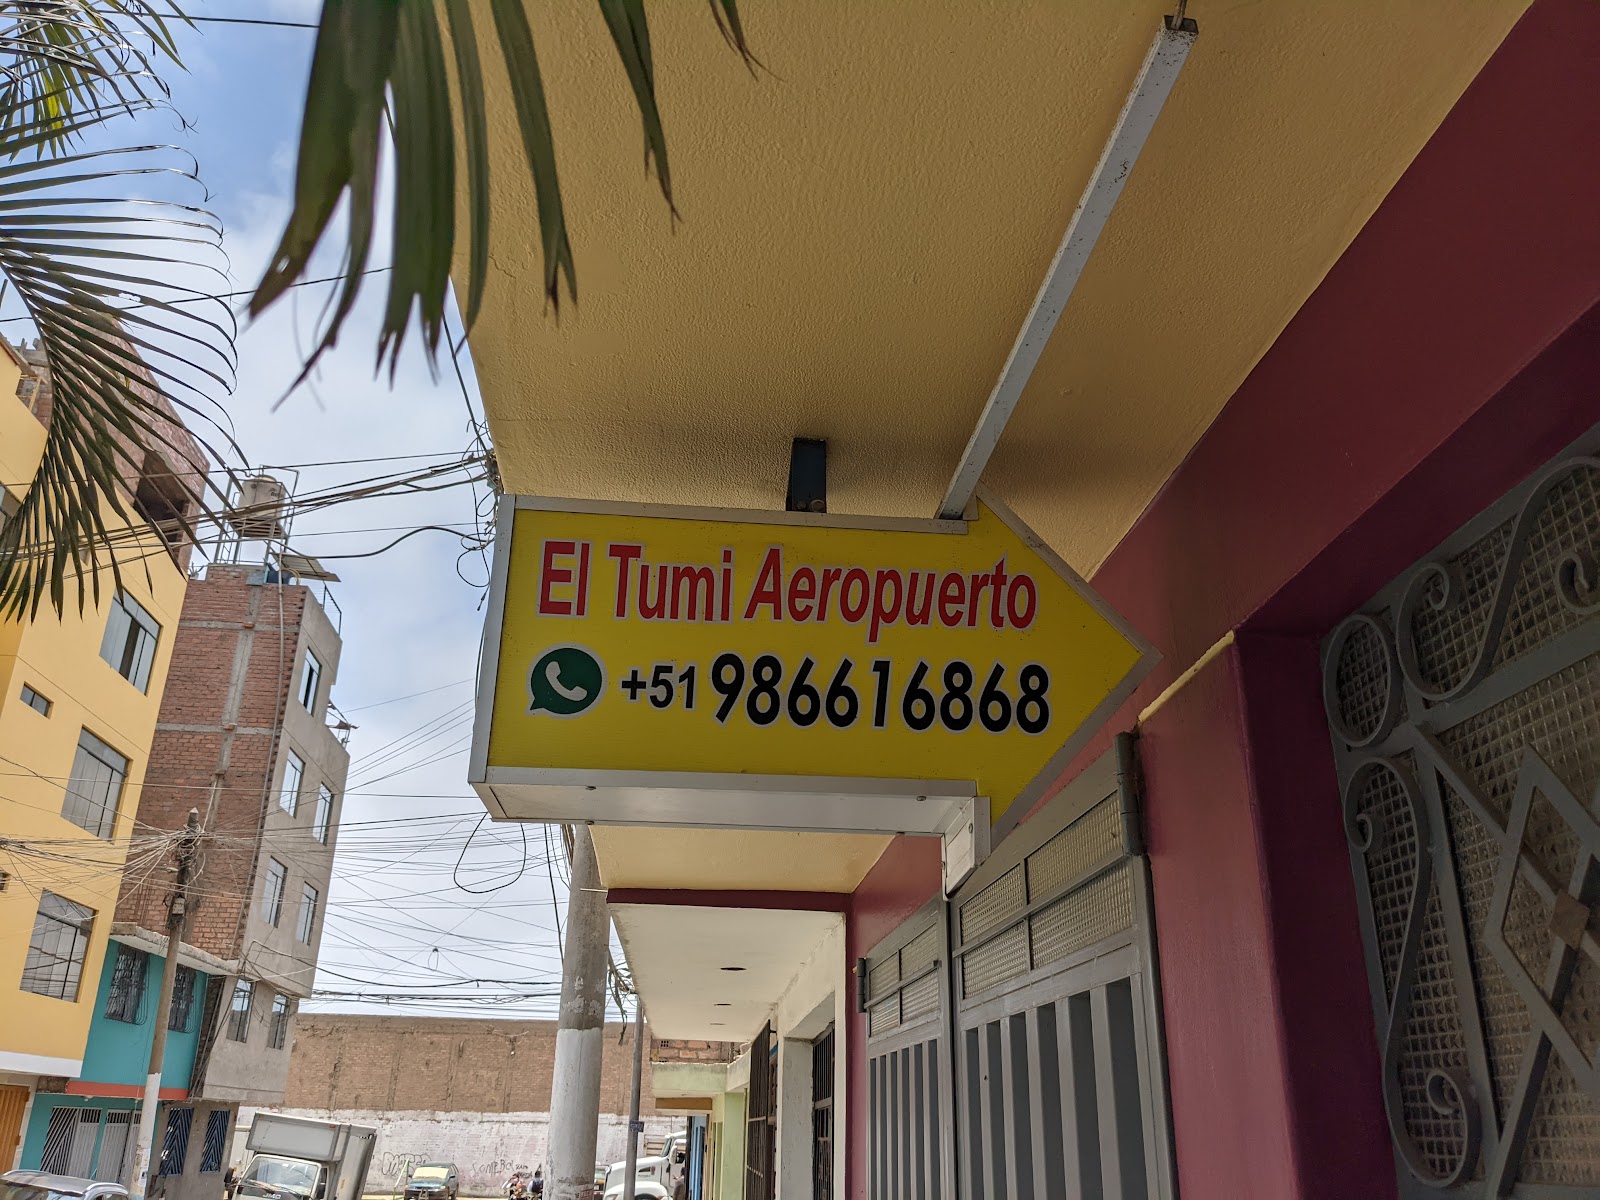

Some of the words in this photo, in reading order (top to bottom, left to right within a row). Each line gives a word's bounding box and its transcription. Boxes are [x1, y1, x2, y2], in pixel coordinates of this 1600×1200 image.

[540, 541, 589, 616] El
[609, 544, 732, 622] Tumi
[745, 549, 1036, 642] Aeropuerto
[621, 664, 696, 709] +51
[711, 652, 1050, 734] 986616868
